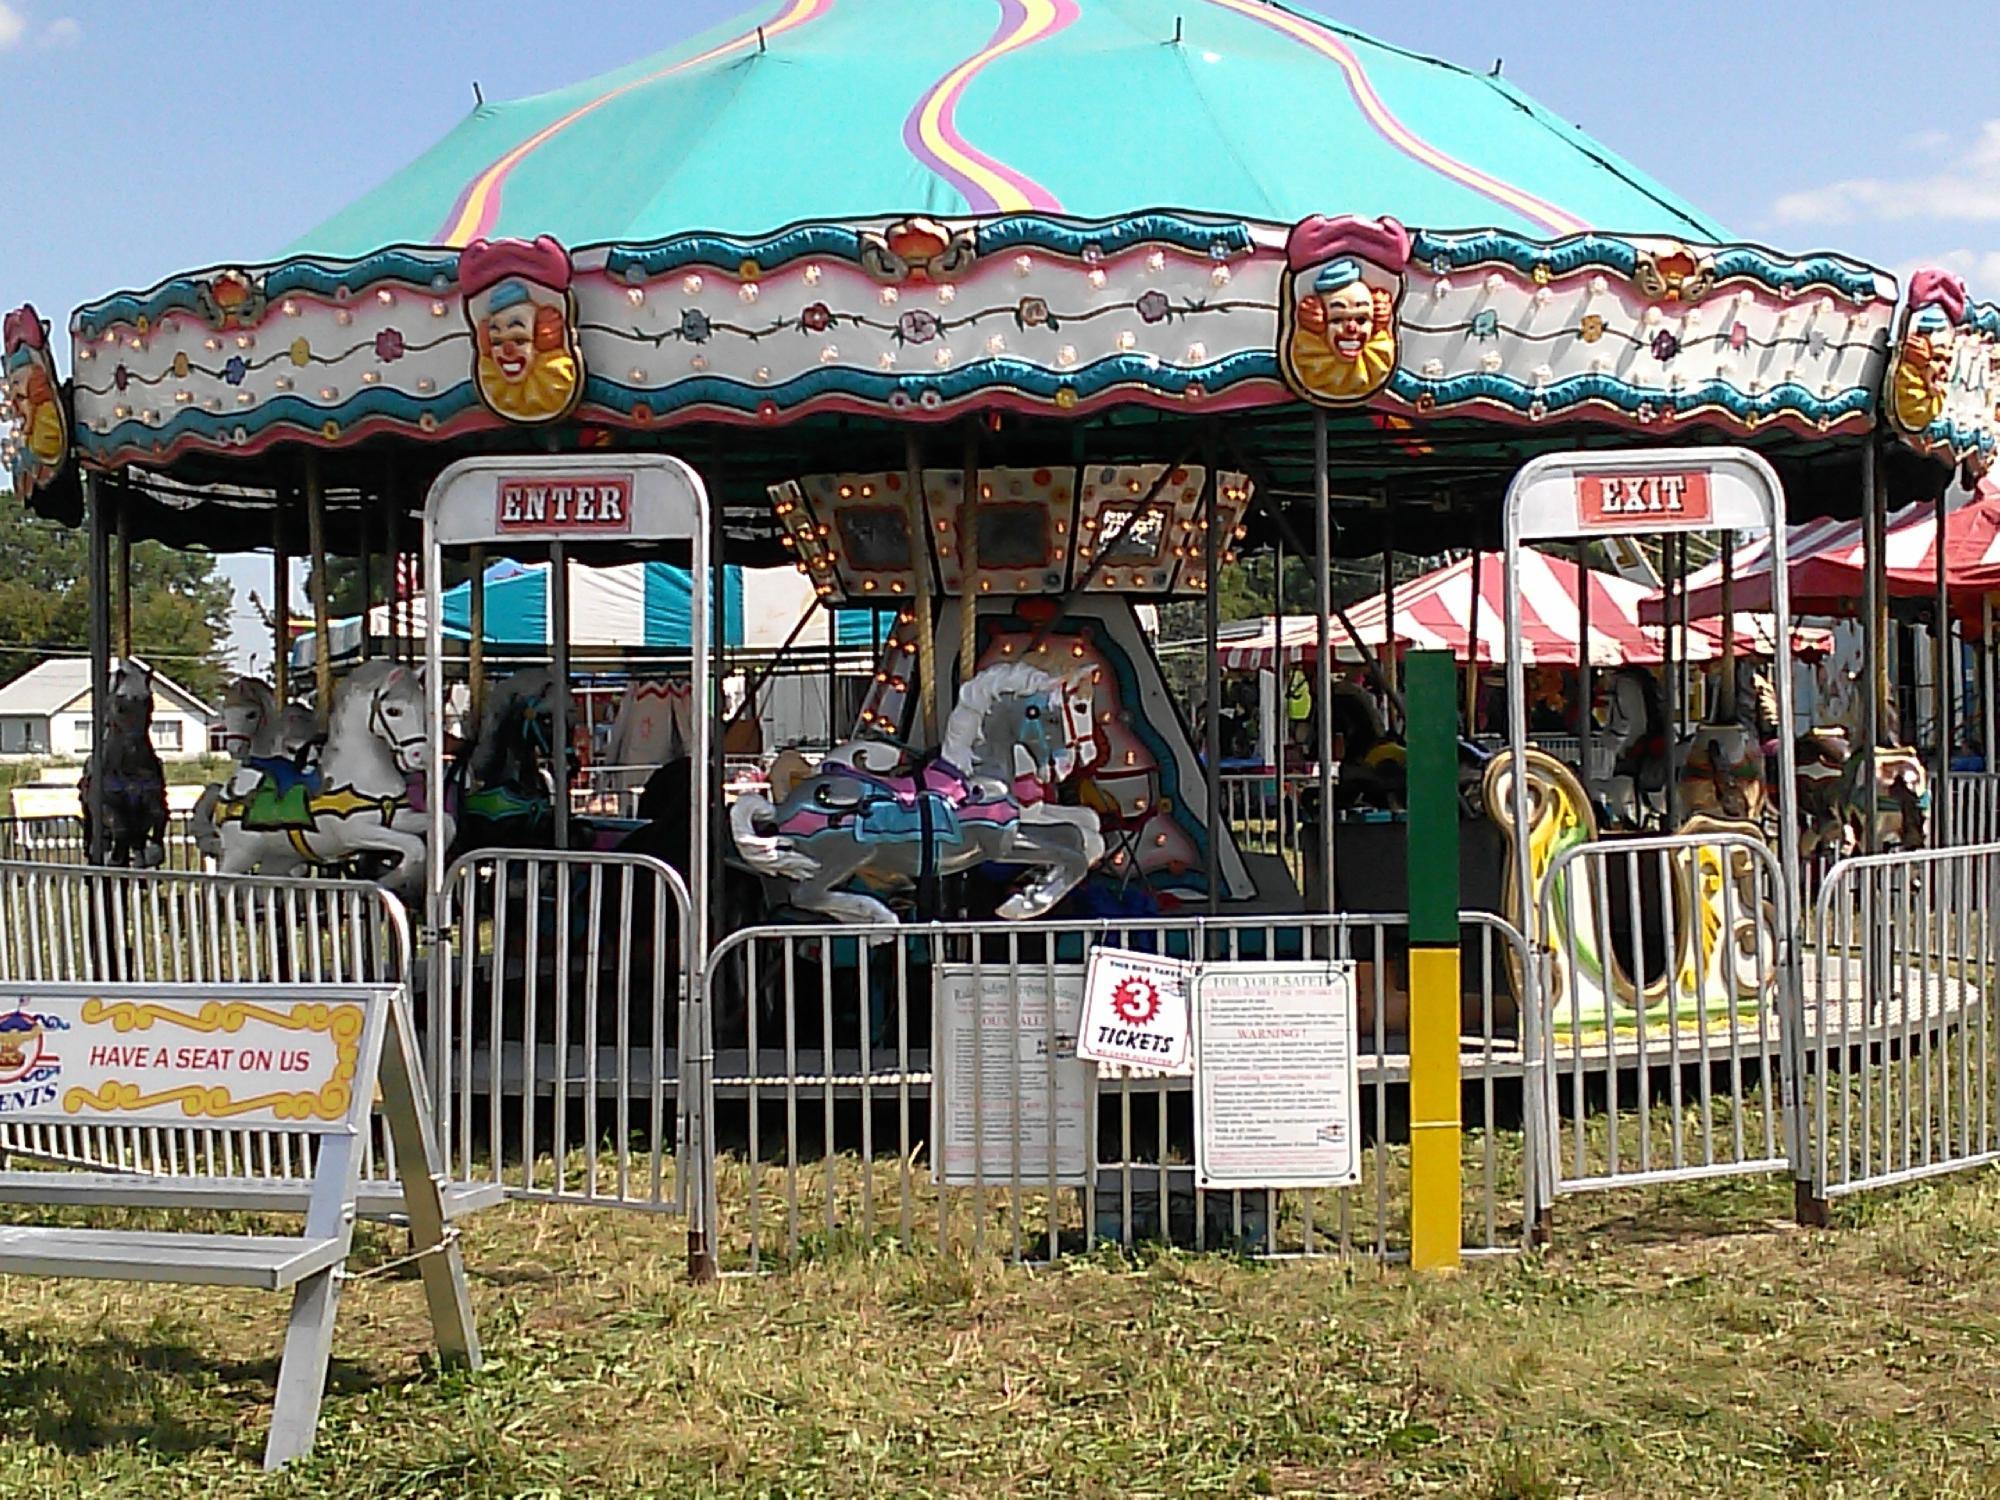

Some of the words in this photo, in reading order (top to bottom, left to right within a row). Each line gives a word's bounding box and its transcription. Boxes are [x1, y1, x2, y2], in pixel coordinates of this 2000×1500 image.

[502, 485, 623, 521] ENTER
[1600, 475, 1686, 512] EXIT
[1213, 976, 1243, 989] FOR
[1243, 976, 1280, 988] YOUR
[1281, 975, 1332, 987] SAFET
[1122, 982, 1152, 1017] 3
[1098, 1026, 1175, 1053] TICKETS
[1237, 1029, 1300, 1039] WARNING
[90, 1046, 151, 1068] HAVE
[153, 1047, 170, 1068] A
[176, 1048, 234, 1071] SEAT
[240, 1050, 273, 1071] ON
[279, 1051, 311, 1072] US
